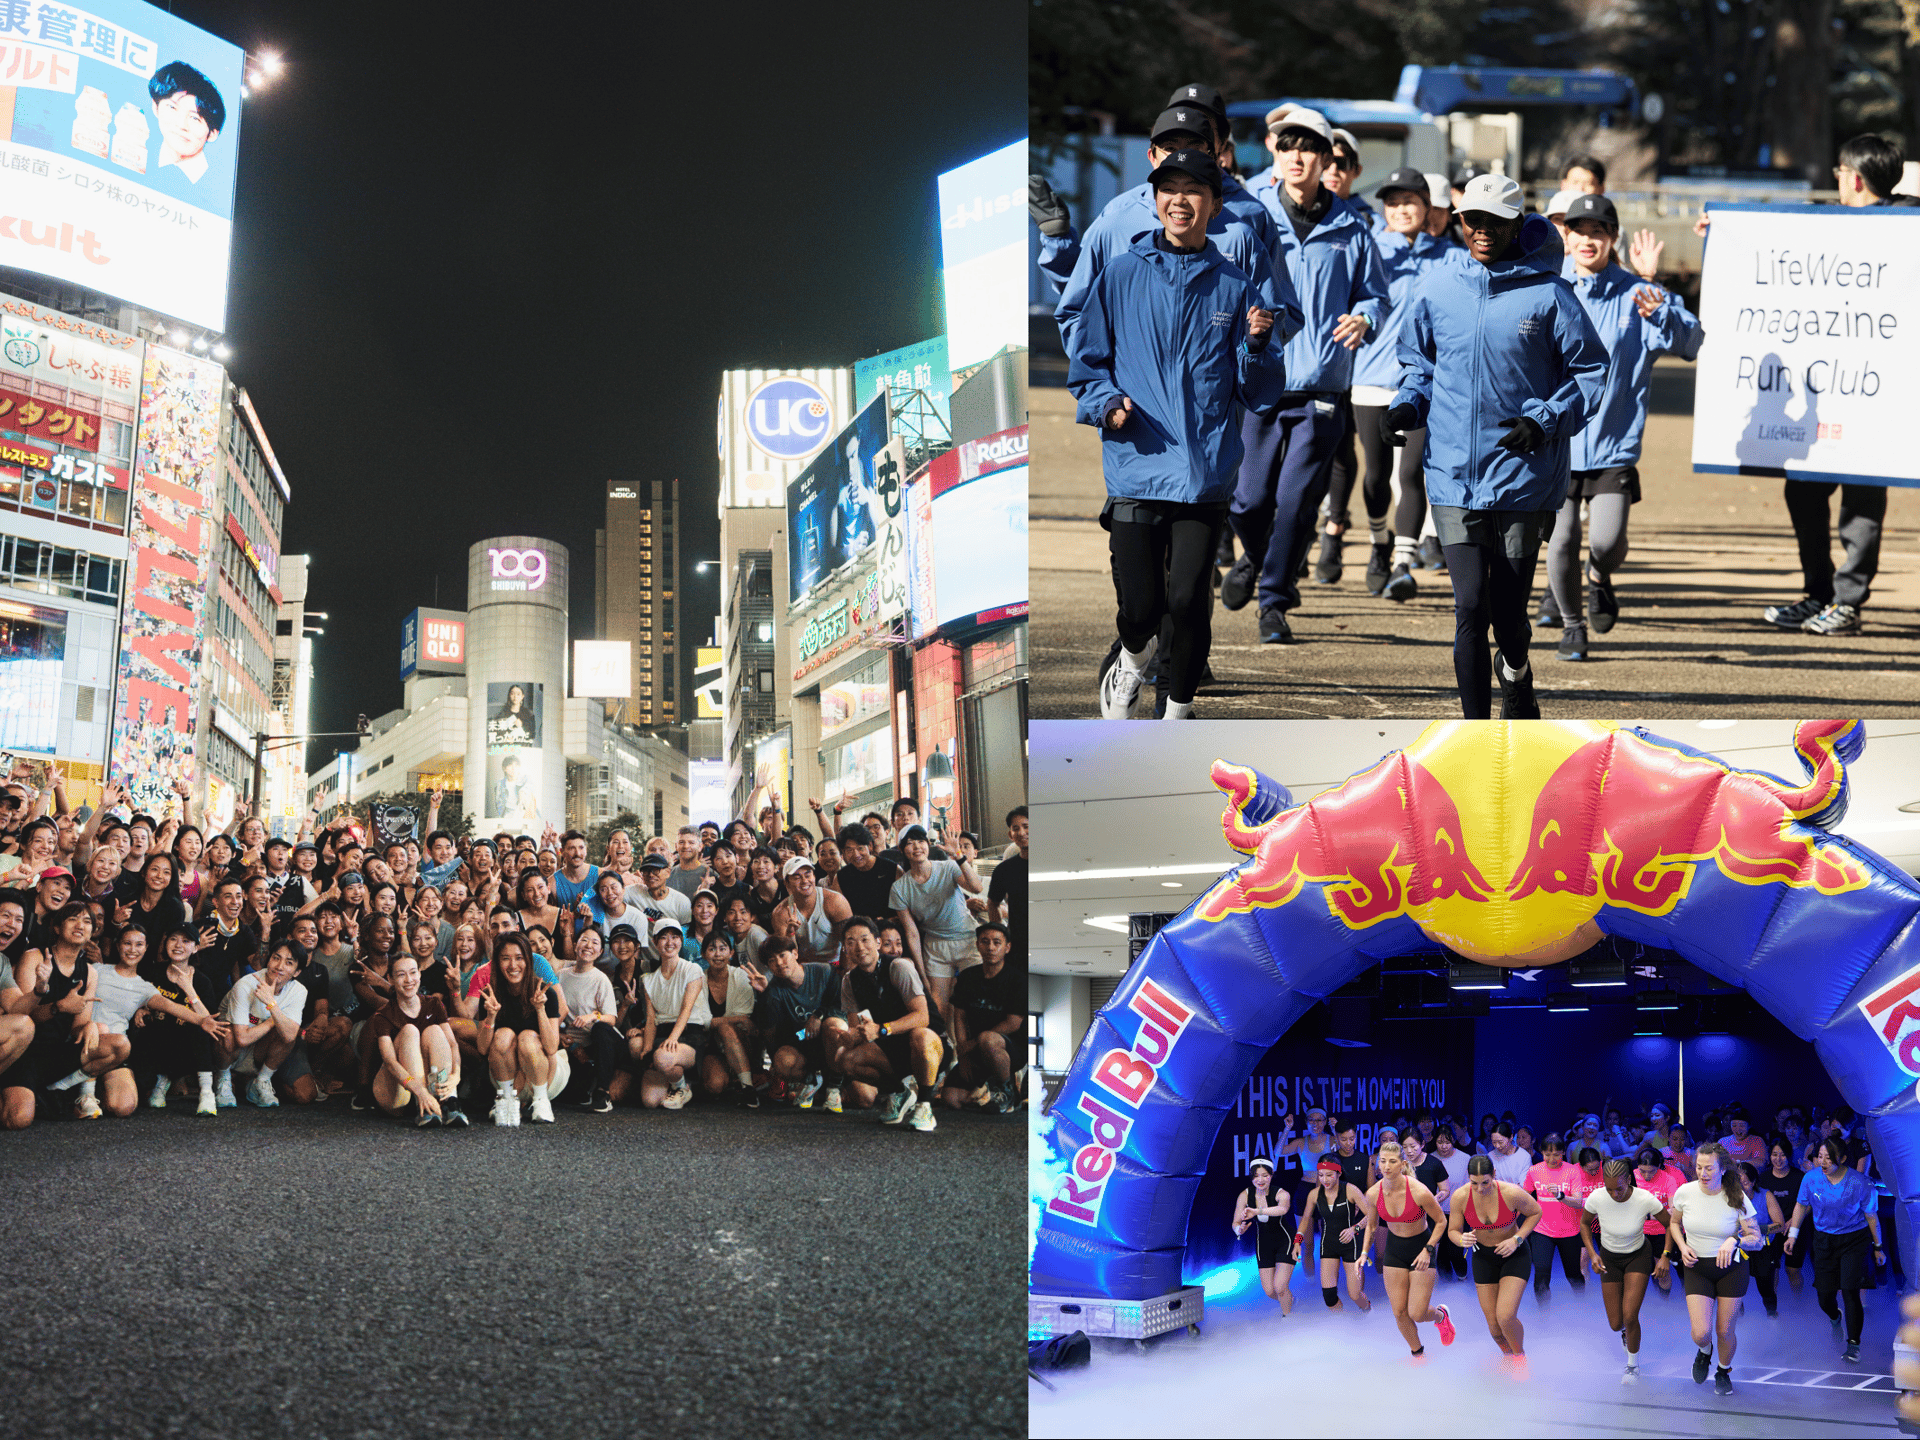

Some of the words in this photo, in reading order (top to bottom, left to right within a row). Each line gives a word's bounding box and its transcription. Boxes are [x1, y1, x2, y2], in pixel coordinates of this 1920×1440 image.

[0, 46, 70, 85] ルト
[1755, 249, 1887, 289] LifeWear
[0, 301, 136, 350] ゃぶしゃぶバイキング
[1736, 301, 1897, 343] magazine
[49, 344, 132, 389] しゃぶ葉
[1736, 356, 1793, 393] Run
[1806, 359, 1880, 397] Club
[0, 445, 48, 468] レストラン
[50, 453, 115, 488] ガスト
[609, 491, 637, 499] INDIGO
[877, 450, 905, 608] もんじゃ
[489, 548, 547, 590] 109
[491, 580, 527, 591] SHIBUYA
[427, 622, 457, 641] UNI
[426, 640, 460, 665] QLO
[643, 907, 664, 919] NIKE
[1046, 1091, 1135, 1228] Red
[1091, 976, 1197, 1110] Bull
[1237, 1076, 1288, 1118] THIS
[1295, 1076, 1314, 1114] IS
[1317, 1077, 1352, 1112] THE
[1357, 1077, 1416, 1111] MOMENT
[1419, 1078, 1445, 1109] YOU
